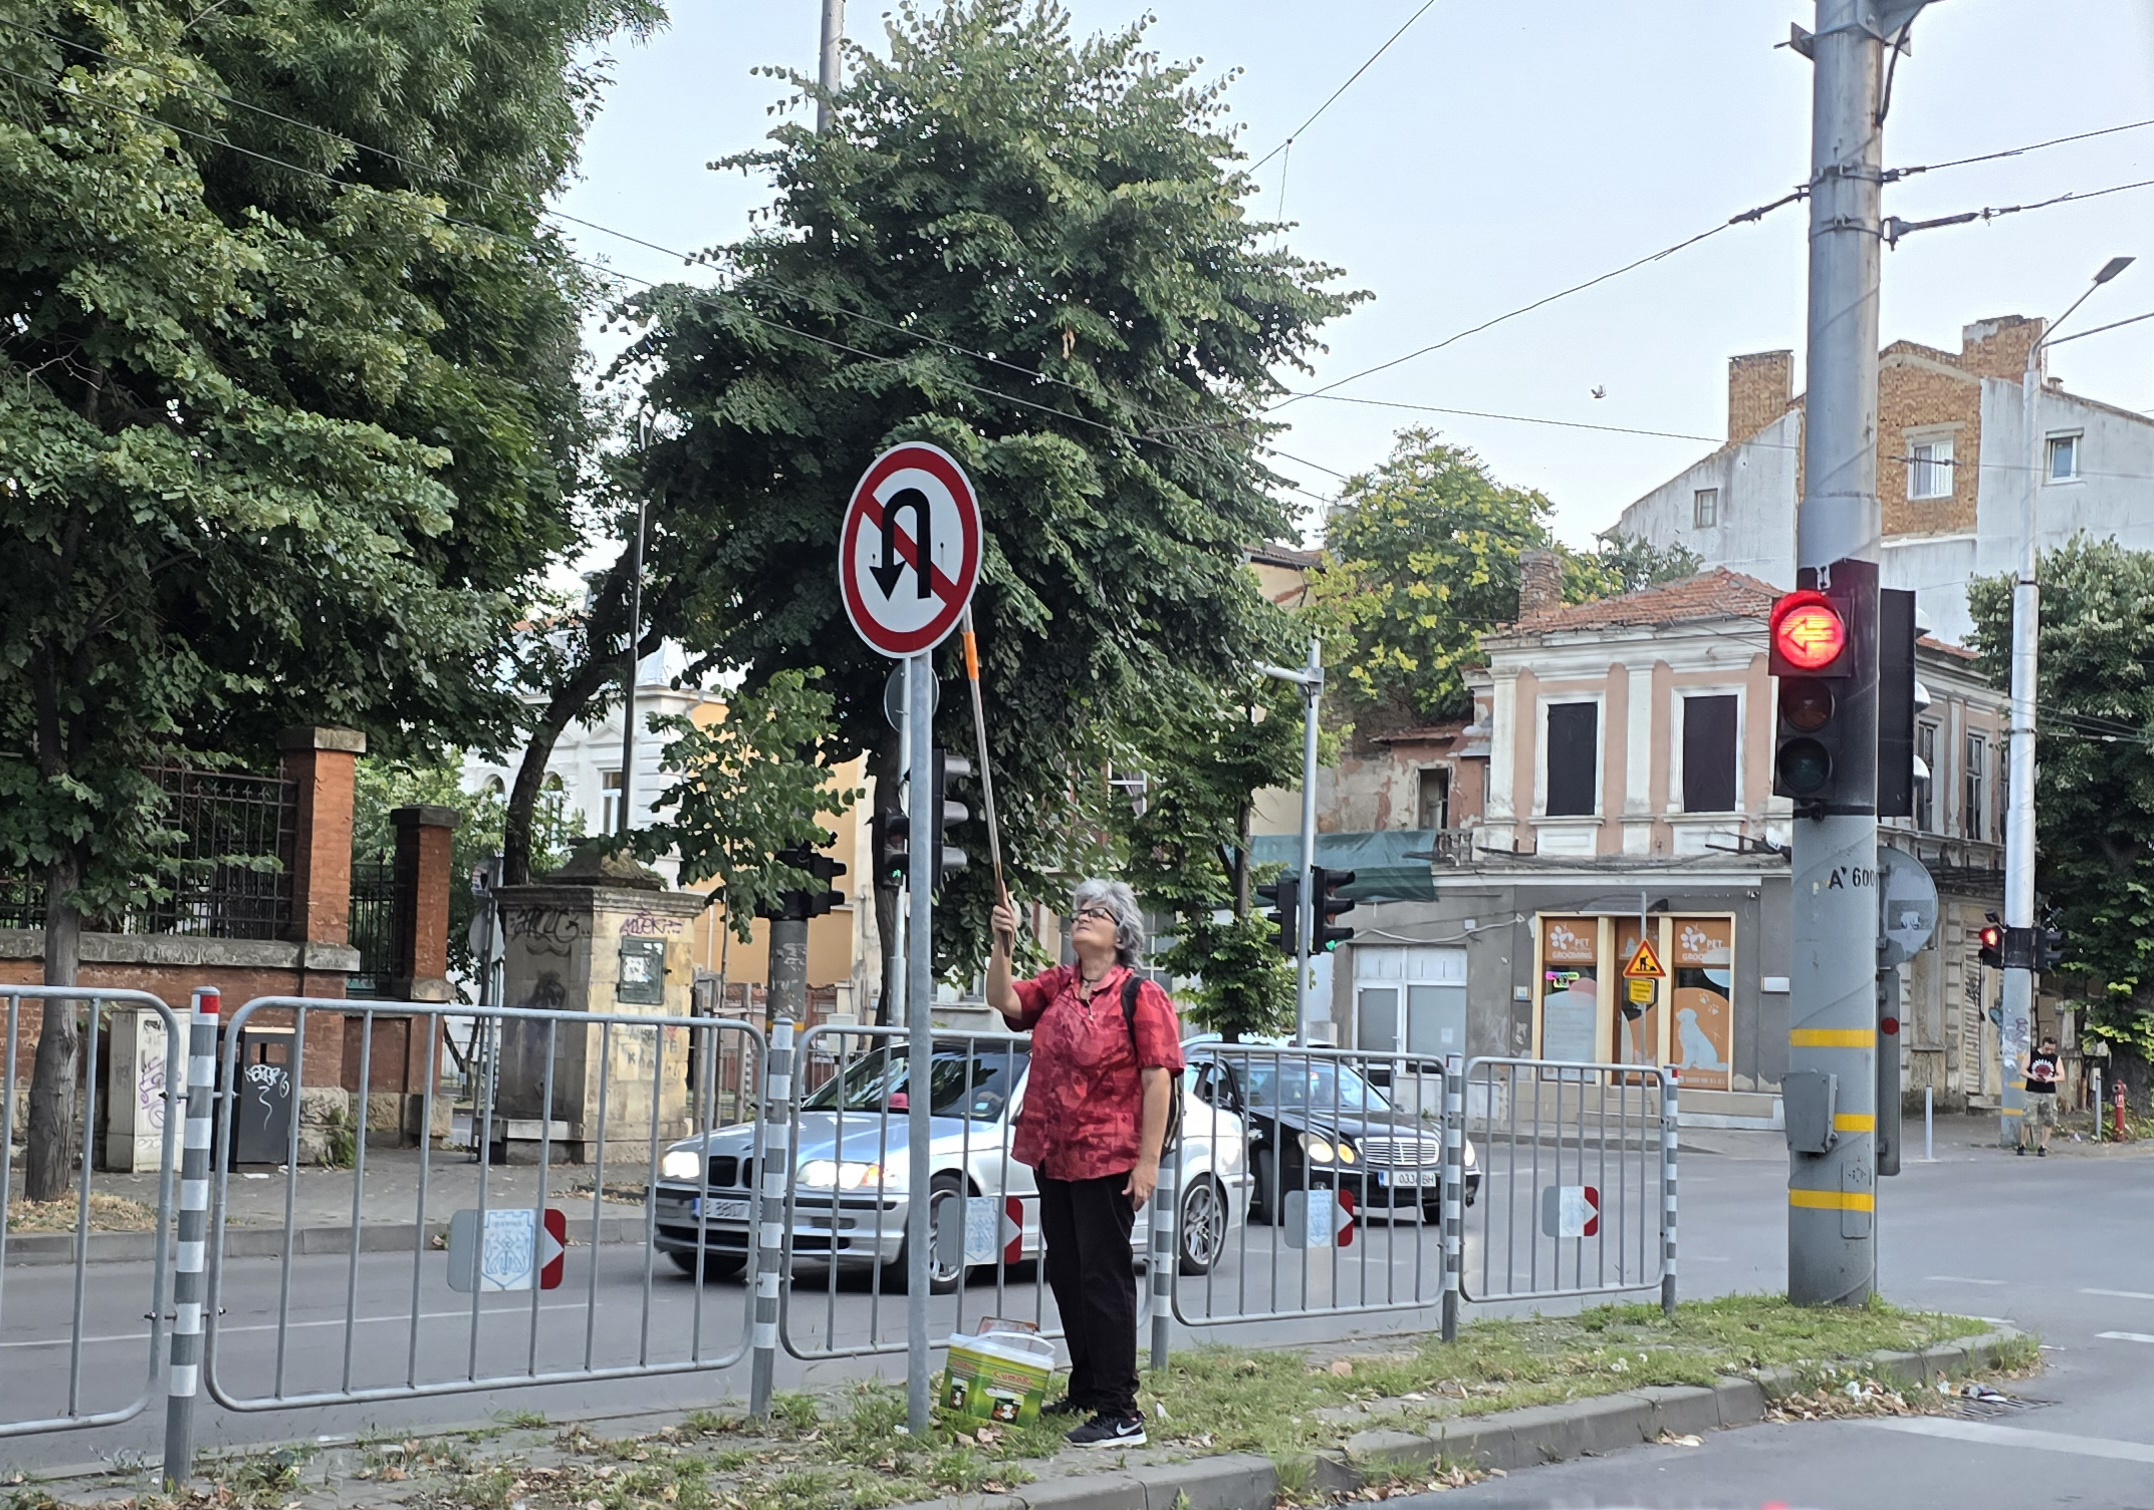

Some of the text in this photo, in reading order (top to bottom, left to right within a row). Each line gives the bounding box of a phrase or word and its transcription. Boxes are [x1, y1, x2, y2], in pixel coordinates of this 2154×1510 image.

[1574, 938, 1590, 947] PET
[1706, 939, 1724, 948] PET
[1552, 951, 1593, 960] GROOMING
